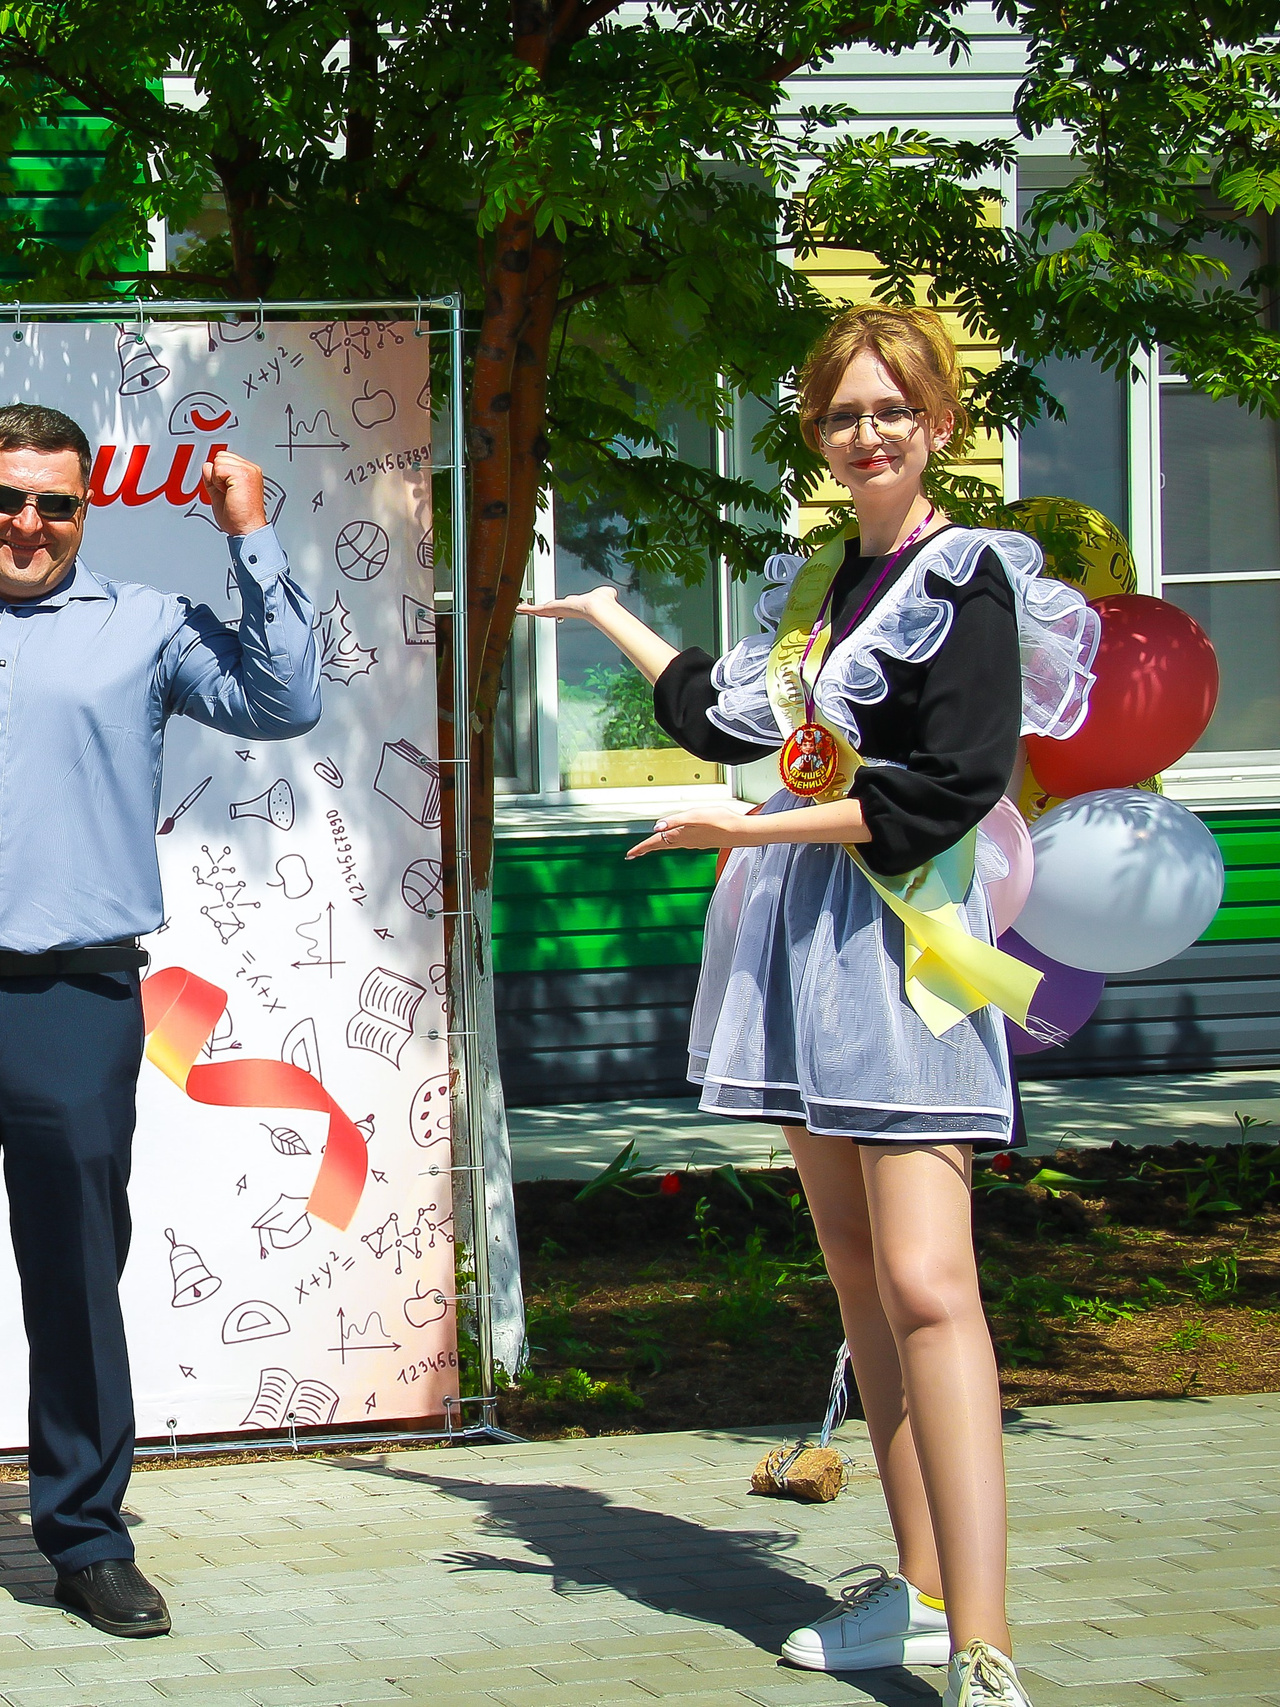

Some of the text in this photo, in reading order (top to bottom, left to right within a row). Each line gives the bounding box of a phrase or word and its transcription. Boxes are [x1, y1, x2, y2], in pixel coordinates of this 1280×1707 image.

[787, 773, 828, 789] УЧЕНИЦЕ
[326, 809, 368, 907] 1234567890
[396, 1350, 458, 1385] 123456
